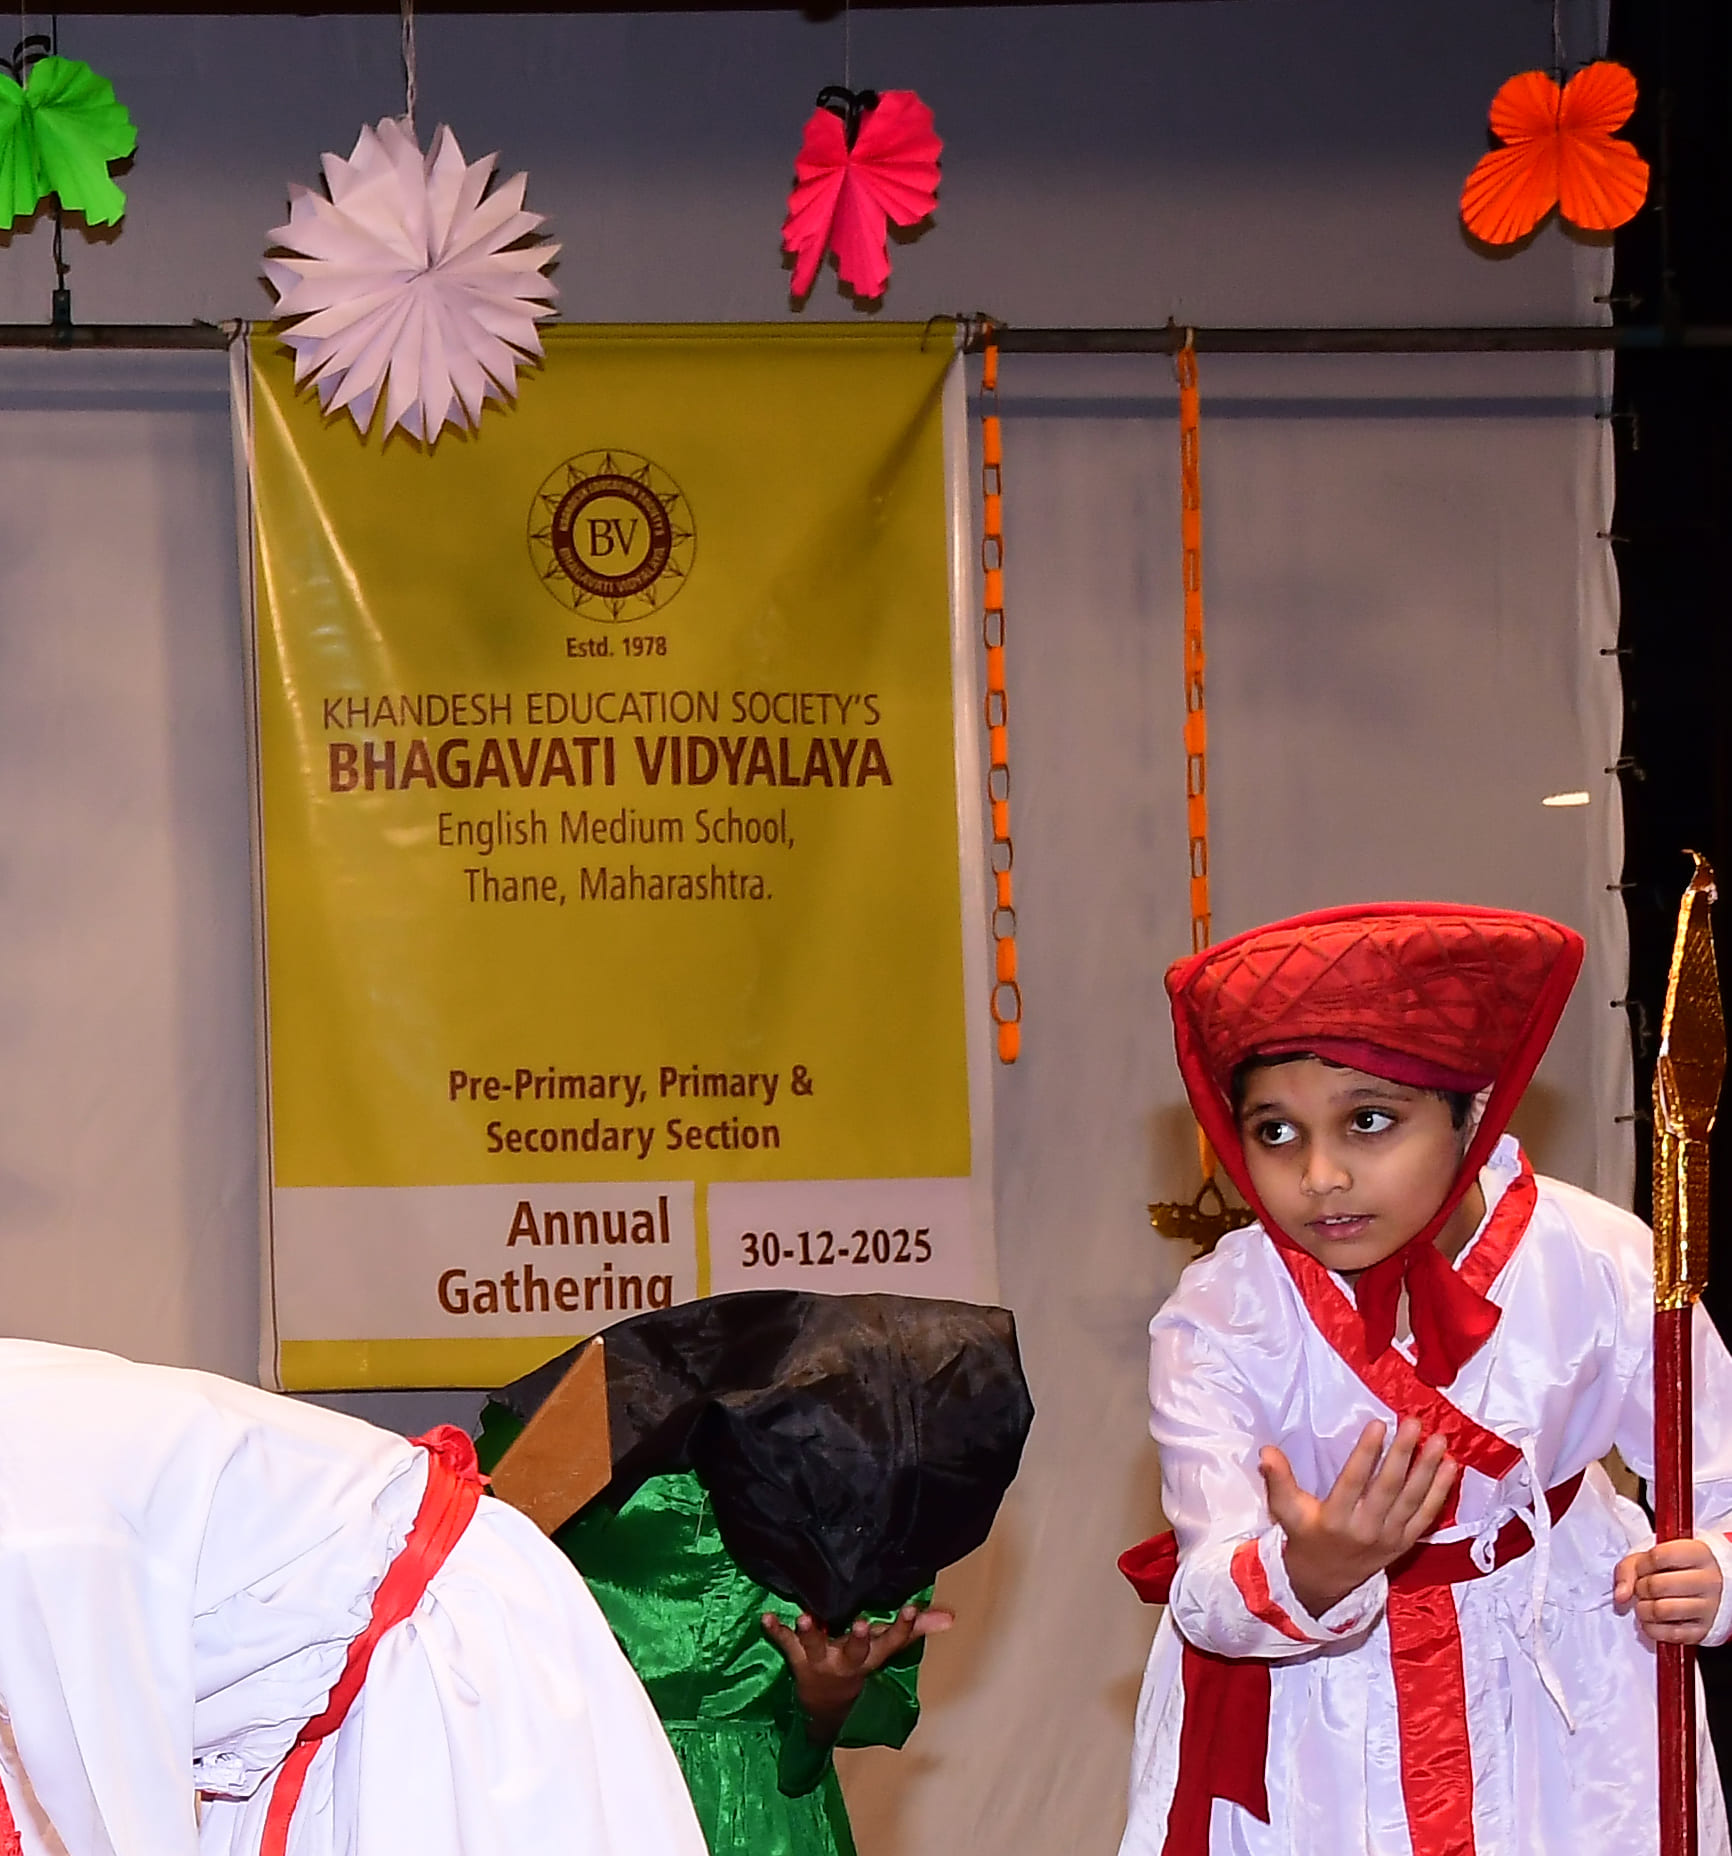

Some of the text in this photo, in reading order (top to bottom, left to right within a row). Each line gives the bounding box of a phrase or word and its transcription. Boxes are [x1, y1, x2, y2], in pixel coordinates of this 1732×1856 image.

[587, 518, 638, 556] BV
[567, 636, 667, 658] Estd. 1978
[323, 691, 880, 729] KHANDESH EDUCATION SOCIETY'S
[328, 735, 893, 792] BHAGAVATI VIDYALAYA
[438, 807, 795, 856] English Medium School,
[464, 865, 773, 906] Thane, Maharashtra.
[449, 1064, 813, 1107] Pre-Primary, Primary &
[486, 1117, 780, 1160] Secondary Section
[506, 1196, 670, 1246] Annual
[741, 1228, 933, 1267] 30-12-2025
